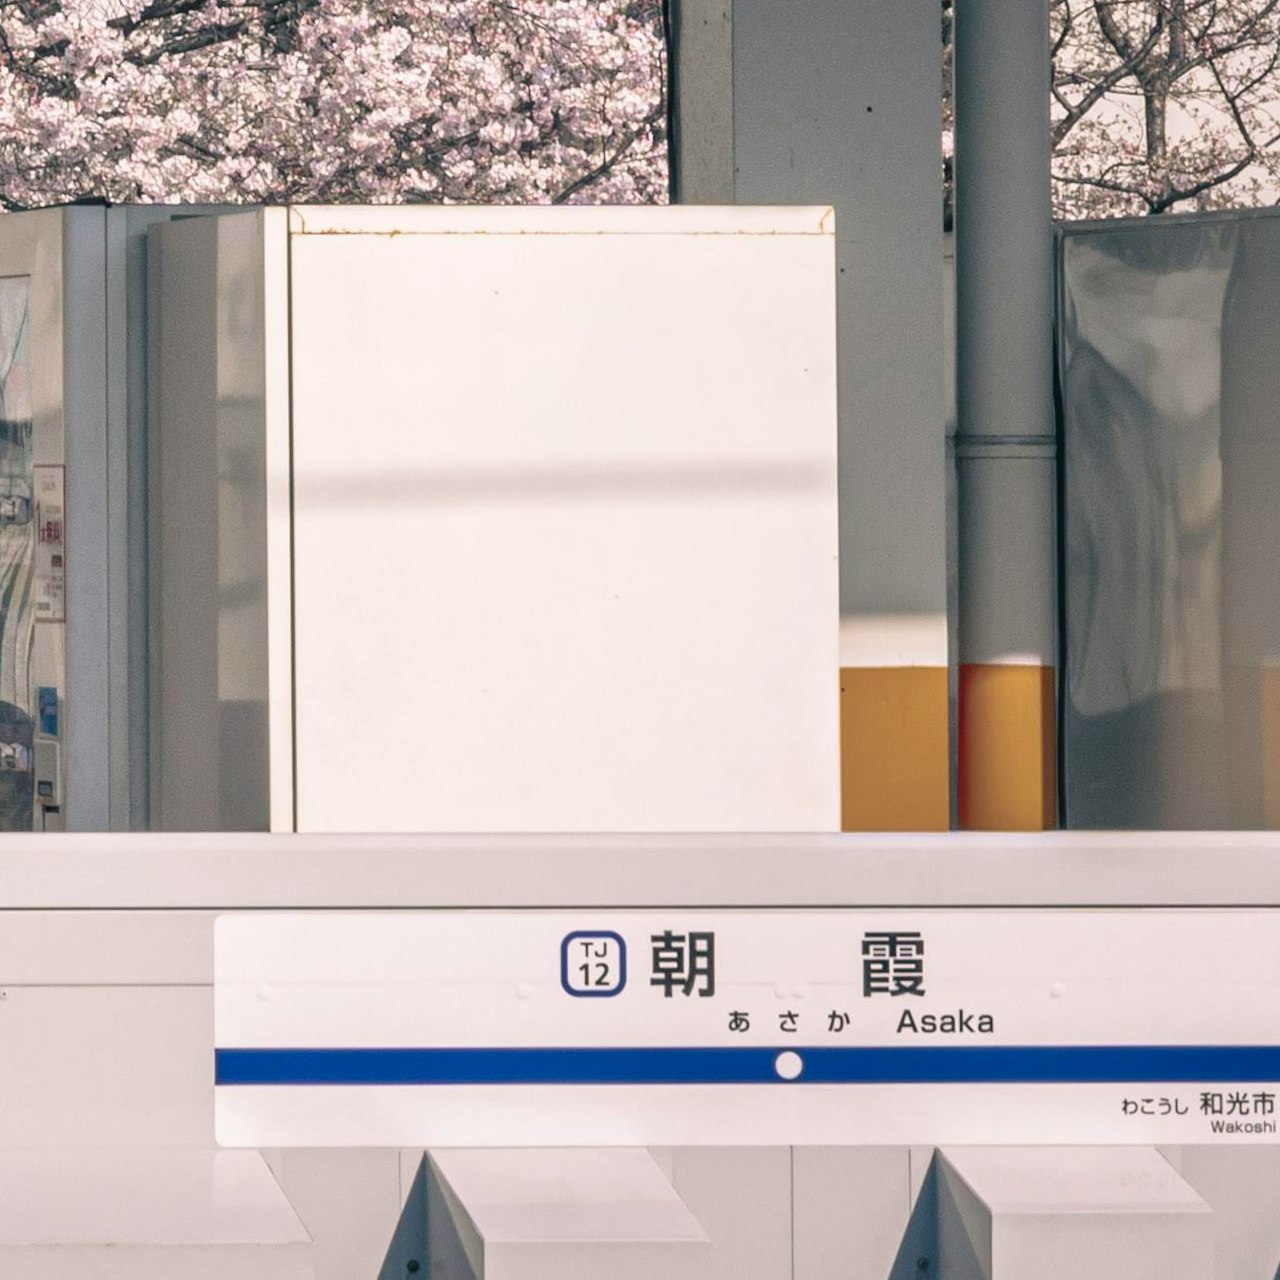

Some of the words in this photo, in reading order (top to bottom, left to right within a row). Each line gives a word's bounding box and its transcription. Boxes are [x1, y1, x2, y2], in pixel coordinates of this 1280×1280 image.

[580, 942, 608, 958] TJ
[579, 962, 610, 986] 12
[896, 1009, 995, 1033] Asaka
[1121, 1097, 1189, 1116] わこうし
[1199, 1091, 1276, 1116] 和光市
[1210, 1120, 1277, 1133] Wakoshi
